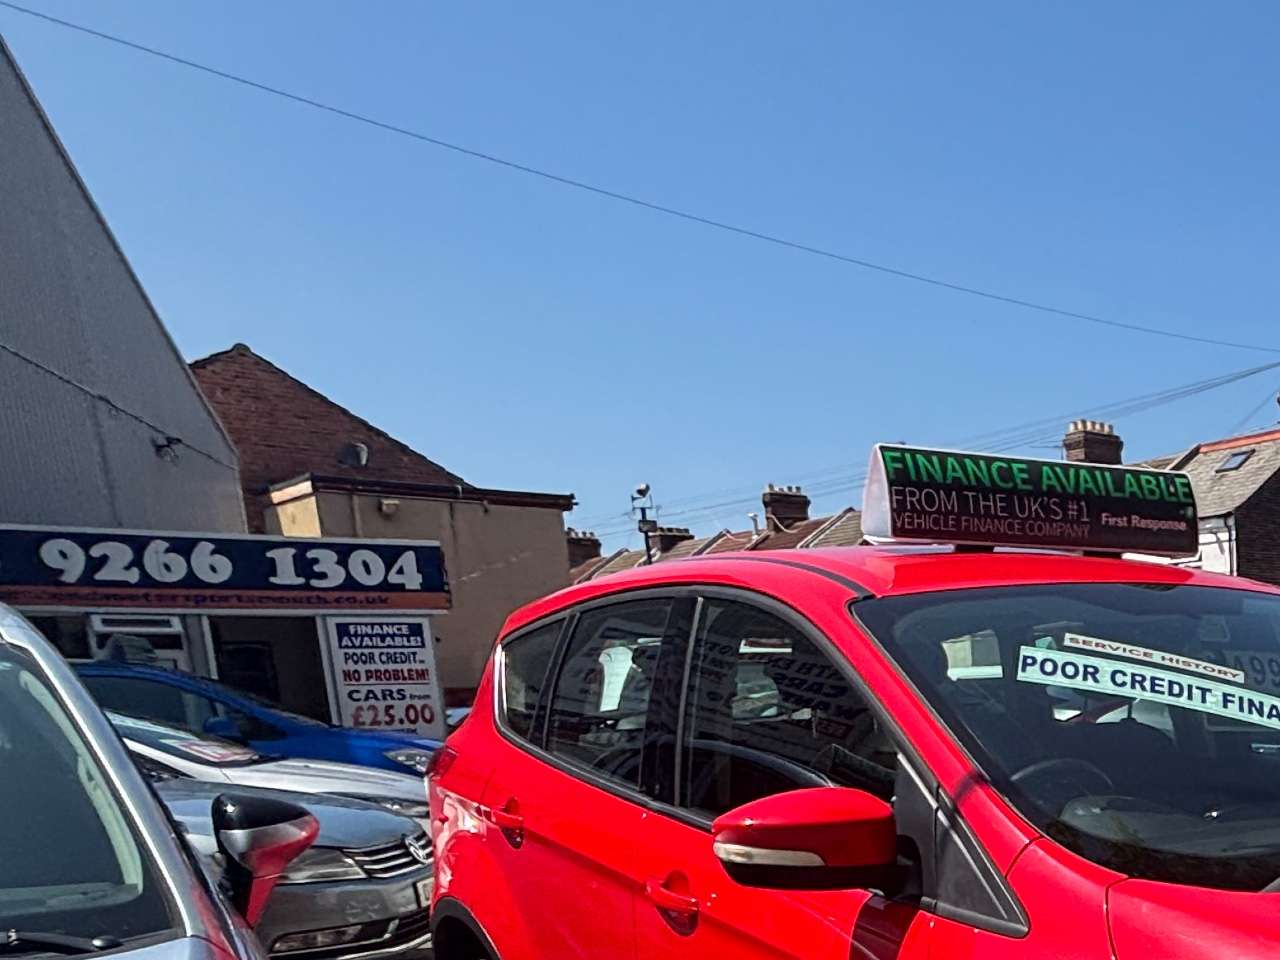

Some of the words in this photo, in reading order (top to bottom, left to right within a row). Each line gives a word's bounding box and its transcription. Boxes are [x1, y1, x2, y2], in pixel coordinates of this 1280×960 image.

[881, 450, 1033, 491] FINANCE
[1041, 465, 1193, 502] AVAILABLE
[891, 486, 958, 515] FROM
[963, 491, 1008, 517] THE
[1013, 496, 1063, 521] UK'S
[1067, 501, 1090, 522] #1
[894, 511, 957, 532] VEHICLE
[961, 516, 1024, 536] FINANCE
[1025, 519, 1090, 538] COMPANY
[1101, 512, 1129, 528] First
[1131, 515, 1188, 532] Response
[39, 538, 233, 584] 9266
[266, 547, 423, 591] 1304
[349, 624, 410, 635] FINANCE
[341, 636, 422, 647] AVAILABLE!
[343, 651, 377, 665] POOR
[1069, 636, 1154, 659] SERVICE
[1160, 655, 1241, 679] HISTORY
[342, 668, 361, 682] NO
[364, 668, 430, 681] PROBLEM!
[1020, 654, 1102, 684] POOR
[1110, 669, 1213, 706] CREDIT
[347, 688, 407, 702] CARS
[352, 703, 435, 726] £25.00
